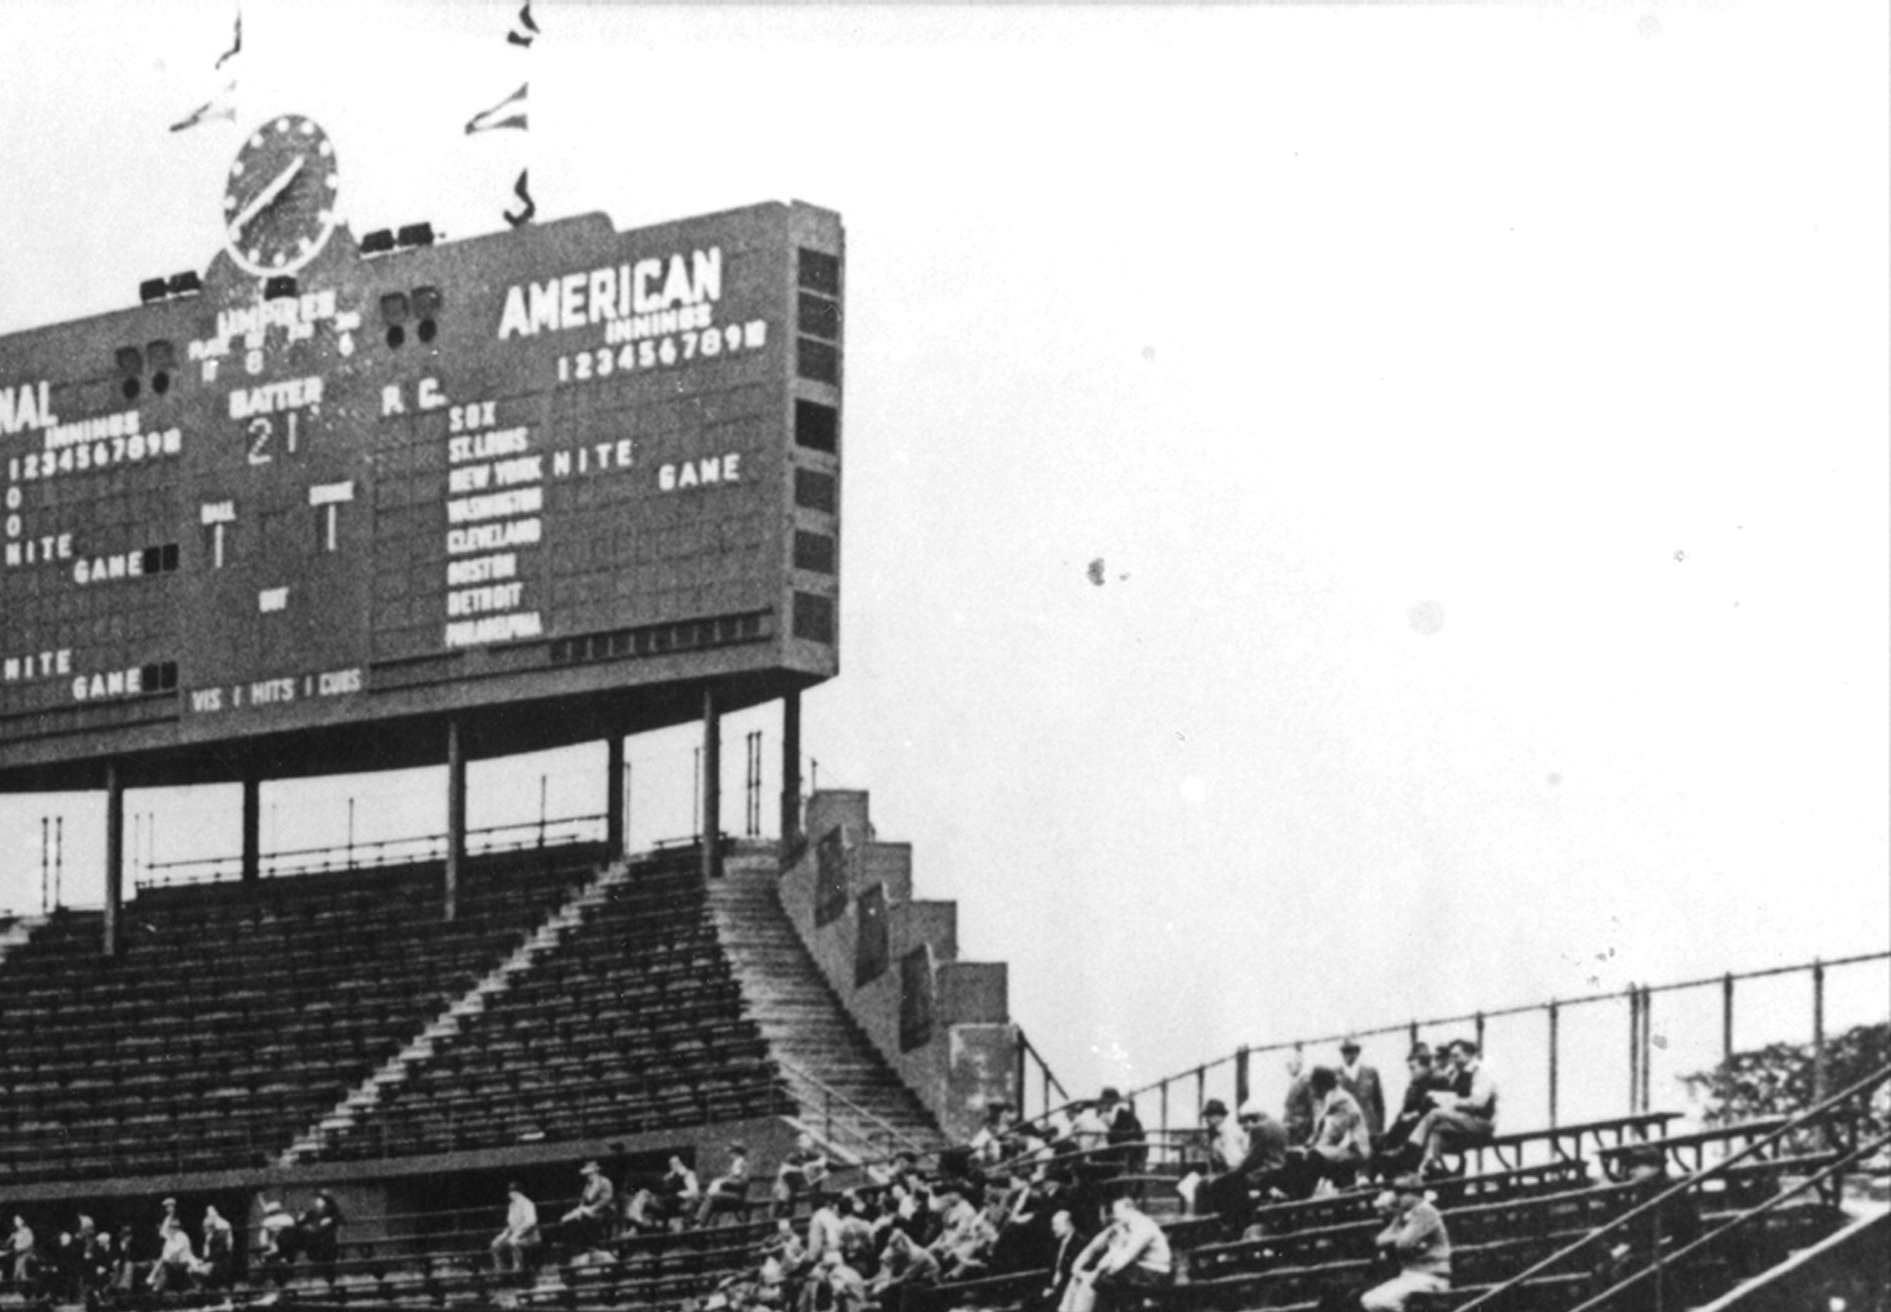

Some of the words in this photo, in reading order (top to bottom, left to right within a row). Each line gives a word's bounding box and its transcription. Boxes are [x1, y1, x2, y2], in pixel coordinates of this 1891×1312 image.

[498, 246, 722, 340] AMERICAN
[605, 303, 712, 344] INNINGS
[229, 376, 323, 419] BATTER
[45, 410, 140, 450] INNINGS
[449, 401, 497, 433] SOX
[553, 439, 632, 476] NITE
[658, 454, 740, 491] GAME
[73, 550, 143, 584] GAME
[72, 667, 141, 700] GAME
[192, 687, 221, 712] VIS
[251, 677, 294, 705] HITS
[319, 668, 361, 695] CUBS
